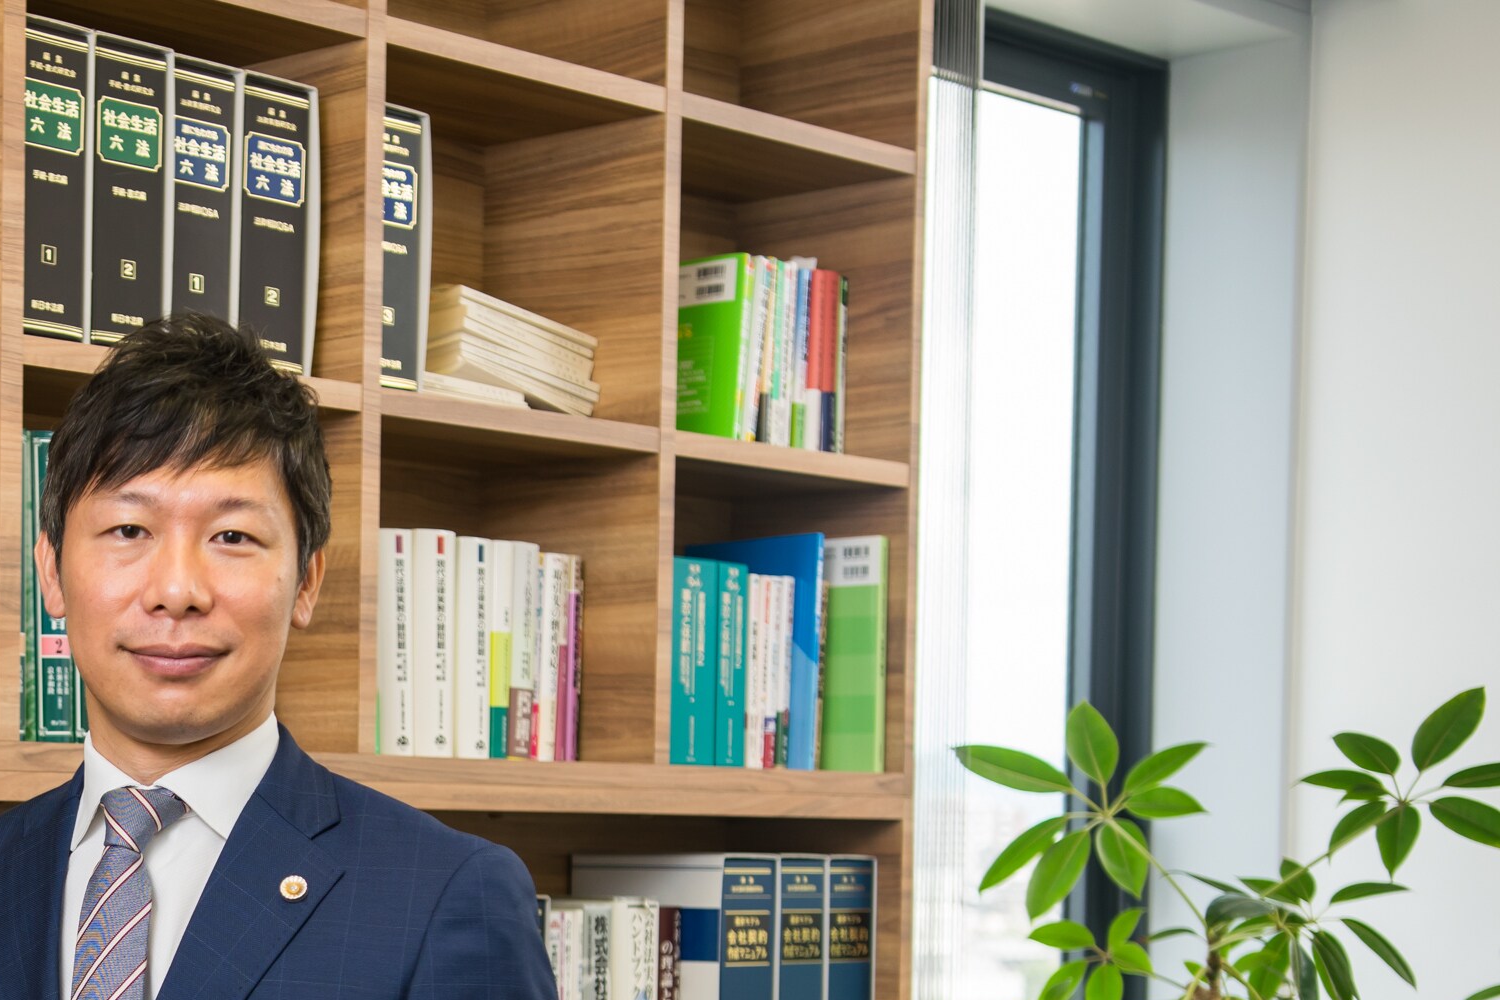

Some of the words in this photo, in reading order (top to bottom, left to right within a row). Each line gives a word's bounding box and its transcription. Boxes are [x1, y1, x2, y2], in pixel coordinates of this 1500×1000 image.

[24, 90, 79, 119] 社会生活
[30, 117, 72, 141] 六法
[103, 109, 157, 135] 社会生活
[110, 135, 150, 158] 六法
[174, 136, 225, 161] 社会生活
[180, 159, 219, 182] 六法
[250, 152, 301, 178] 社会生活
[255, 175, 295, 197] 六法
